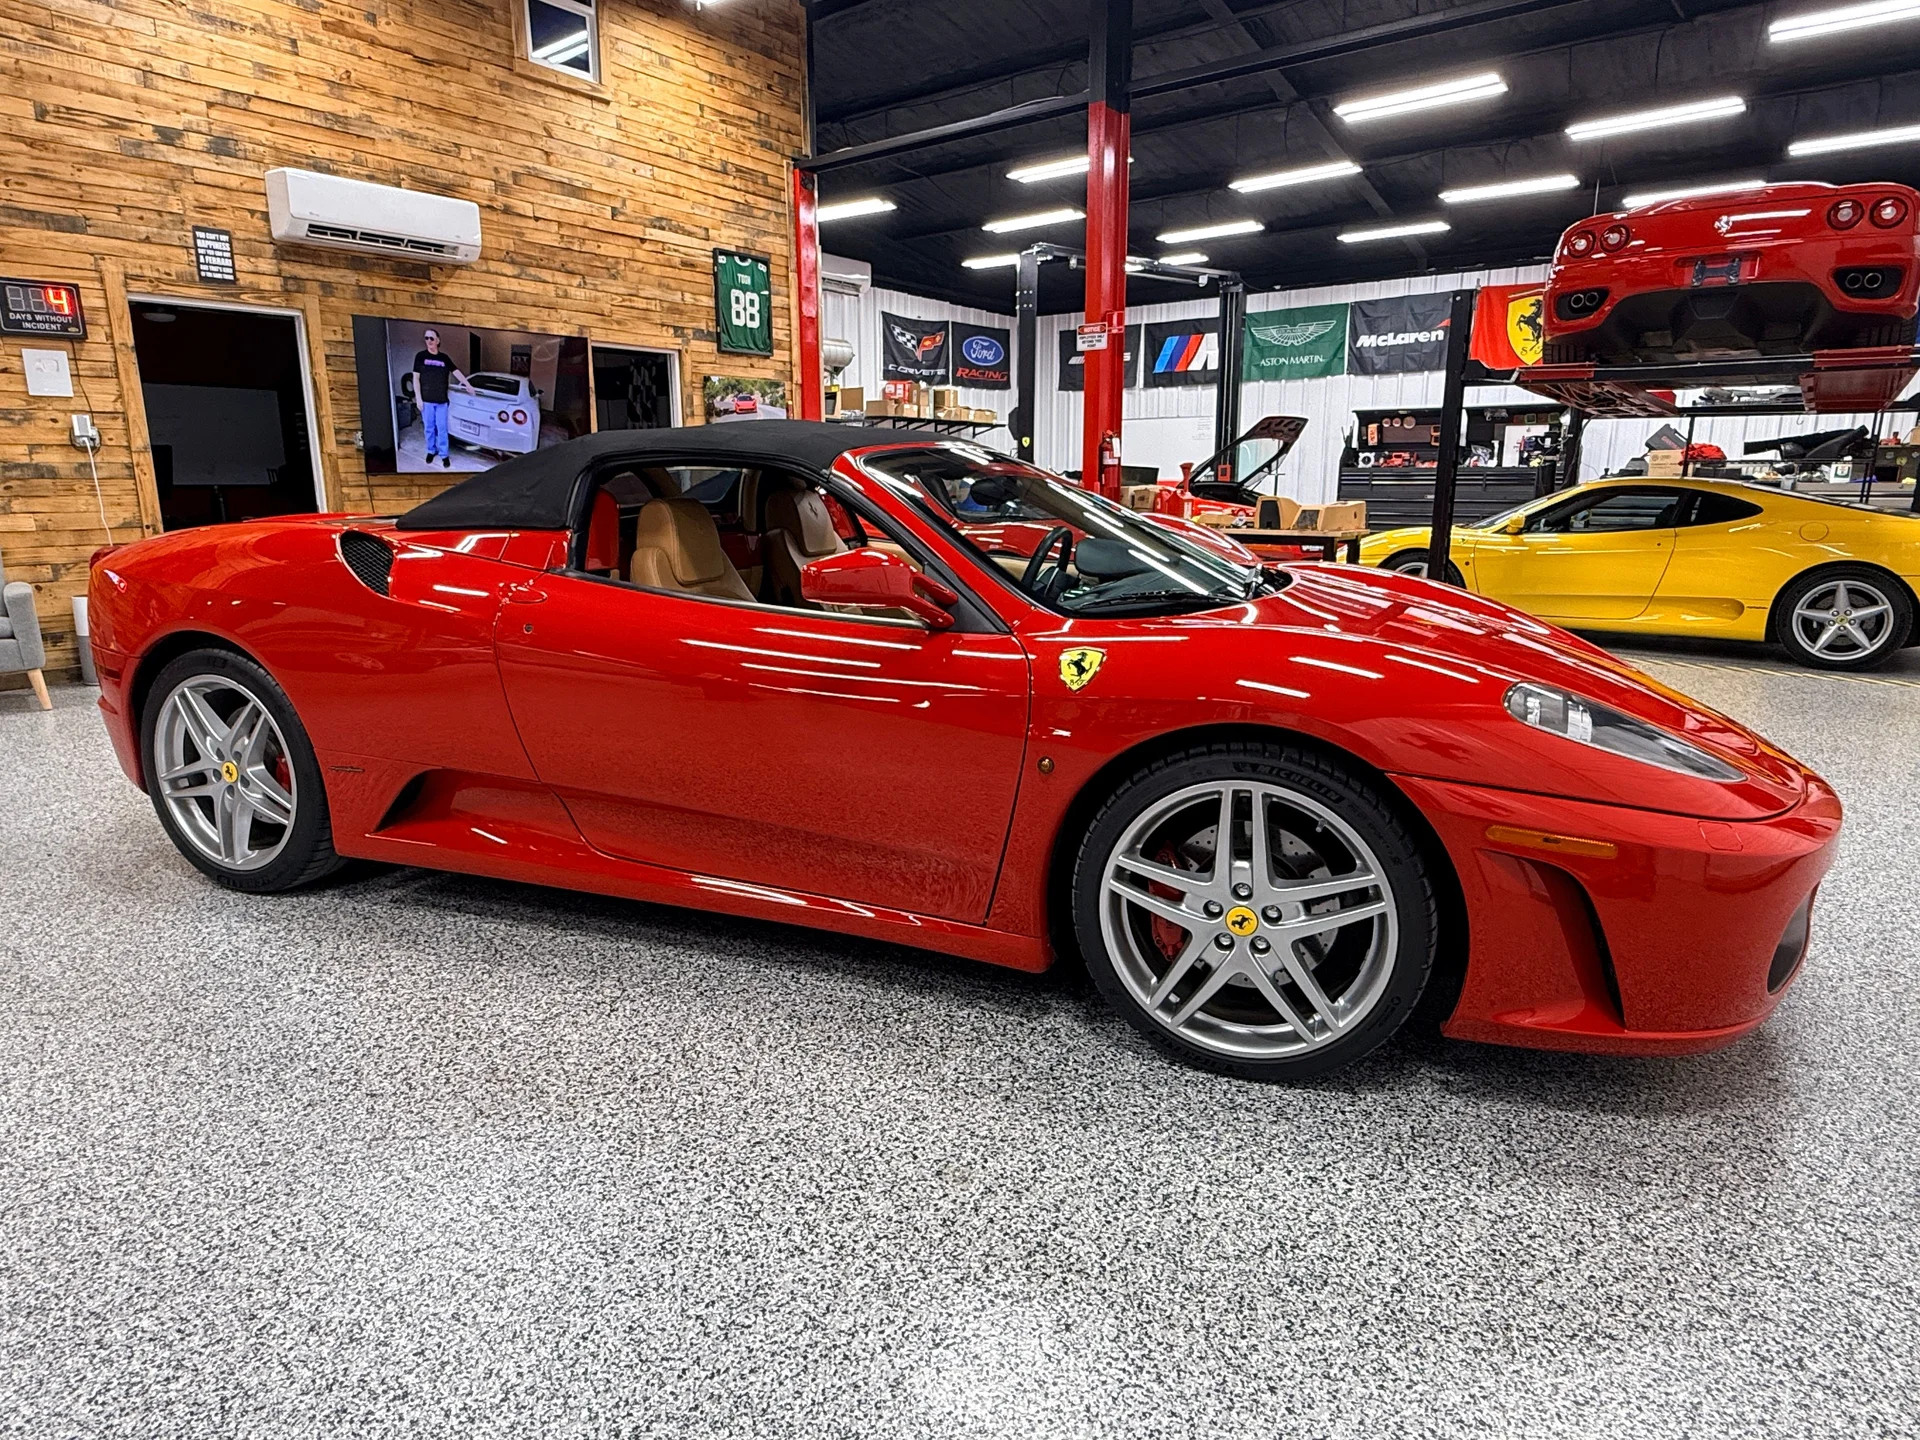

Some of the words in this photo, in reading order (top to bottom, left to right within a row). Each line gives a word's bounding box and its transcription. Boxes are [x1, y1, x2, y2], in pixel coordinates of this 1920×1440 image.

[196, 239, 231, 251] HAPPINESS
[205, 256, 232, 266] FERRARI
[47, 287, 69, 315] 4
[730, 288, 761, 329] 88
[9, 313, 32, 321] DAYS
[34, 314, 72, 324] WITHOUT
[22, 321, 62, 331] INCIDENT
[1356, 328, 1445, 347] McLaren
[970, 340, 996, 361] Ford
[1259, 356, 1289, 367] ASTON
[1289, 354, 1324, 365] MARTIN
[888, 363, 947, 376] CORVETTE
[956, 367, 1008, 381] RACING
[1257, 764, 1341, 801] MICHELIN
